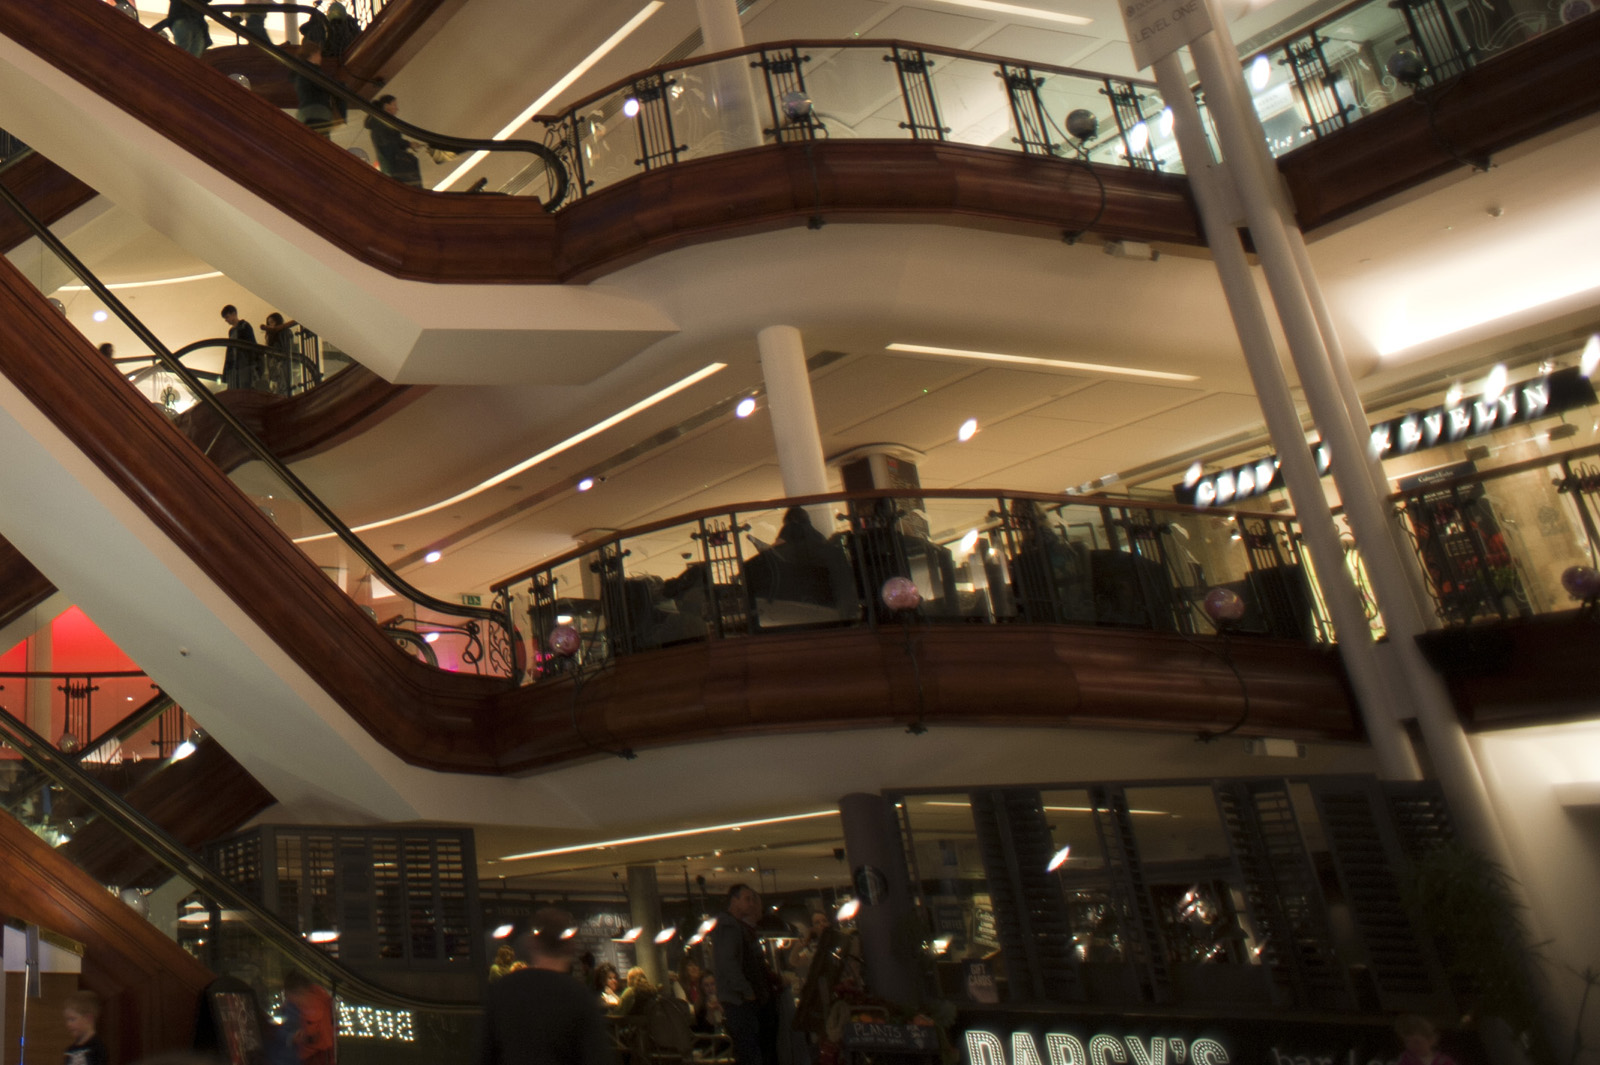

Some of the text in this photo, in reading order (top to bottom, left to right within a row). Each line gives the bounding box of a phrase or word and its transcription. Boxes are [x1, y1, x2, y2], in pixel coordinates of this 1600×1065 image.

[1135, 0, 1198, 44] LEVEL ONE
[1399, 384, 1549, 444] EVELYN
[853, 1022, 902, 1038] PLANTS
